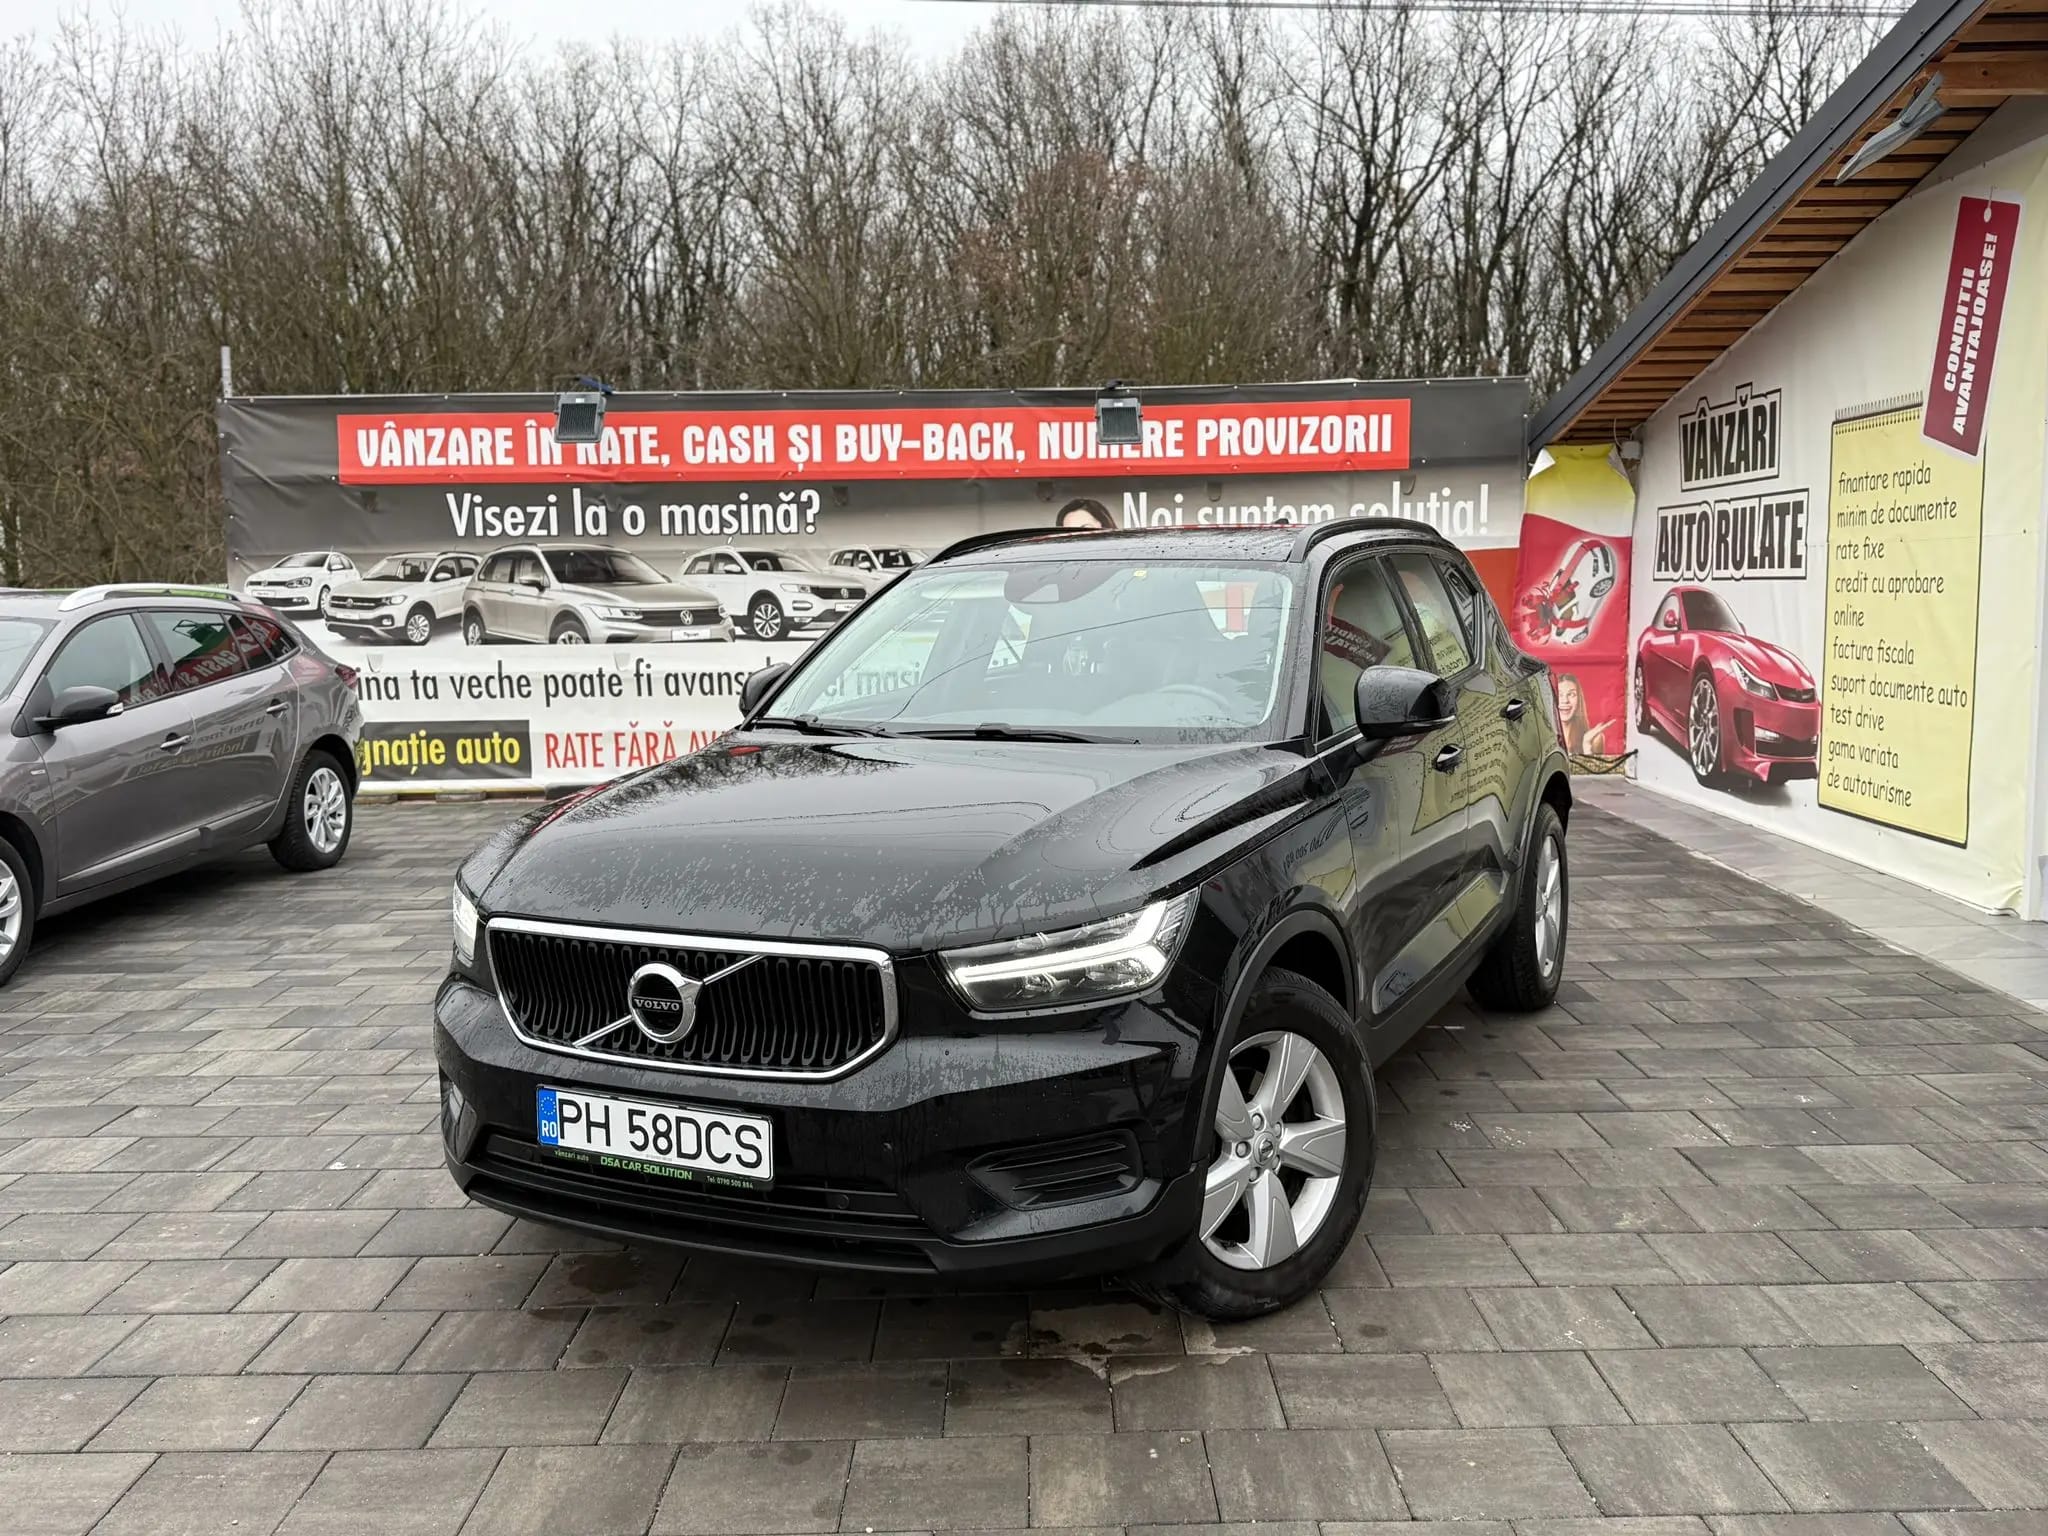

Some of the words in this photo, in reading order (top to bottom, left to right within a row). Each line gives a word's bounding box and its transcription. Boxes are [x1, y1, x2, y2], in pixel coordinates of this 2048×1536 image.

[1943, 267, 1975, 392] CONDITII
[1952, 232, 1998, 436] AVANTAJOASE!
[357, 421, 514, 467] VÂNZARE
[682, 425, 775, 464] CASH
[788, 424, 822, 472] ȘI
[835, 422, 1025, 463] BUY-BACK,
[1197, 413, 1392, 457] PROVIZORII
[1682, 394, 1778, 482] VÂNZĂRI
[1839, 471, 1889, 496] finantare
[1892, 460, 1931, 494] rapida
[446, 493, 559, 537] Visezi
[573, 488, 607, 537] la
[621, 503, 646, 537] o
[660, 489, 821, 545] mașină?
[1123, 492, 1184, 529] Noi
[1837, 505, 1868, 528] minim
[1871, 501, 1885, 525] de
[1888, 497, 1958, 524] documente
[1656, 510, 1712, 573] AUTO
[1715, 500, 1805, 572] RULATE
[1835, 539, 1860, 560] rate
[1863, 536, 1885, 560] fixe
[1835, 570, 1869, 593] credit
[1872, 576, 1885, 594] cu
[1888, 570, 1944, 600] aprobare
[1833, 603, 1865, 627] online
[1833, 635, 1873, 661] factura
[1877, 639, 1915, 665] fiscala
[410, 670, 439, 700] ta
[450, 660, 532, 699] veche
[544, 667, 623, 708] poate
[634, 658, 654, 697] fi
[1831, 673, 1866, 698] suport
[1869, 673, 1935, 703] documente
[1938, 684, 1968, 708] auto
[1830, 703, 1852, 726] test
[1855, 705, 1885, 731] drive
[456, 731, 521, 764] auto
[545, 732, 604, 769] RATE
[614, 720, 677, 768] FĂRĂ
[1828, 739, 1856, 762] gama
[1858, 744, 1899, 769] variata
[1827, 766, 1840, 789] de
[1843, 774, 1912, 807] autoturisme
[634, 998, 680, 1011] VOLVO
[541, 1120, 558, 1137] RO
[558, 1098, 611, 1147] PH
[628, 1108, 763, 1169] 58DCS
[600, 1156, 621, 1168] DSA
[622, 1160, 642, 1172] CAR
[643, 1164, 693, 1180] SOLUTION
